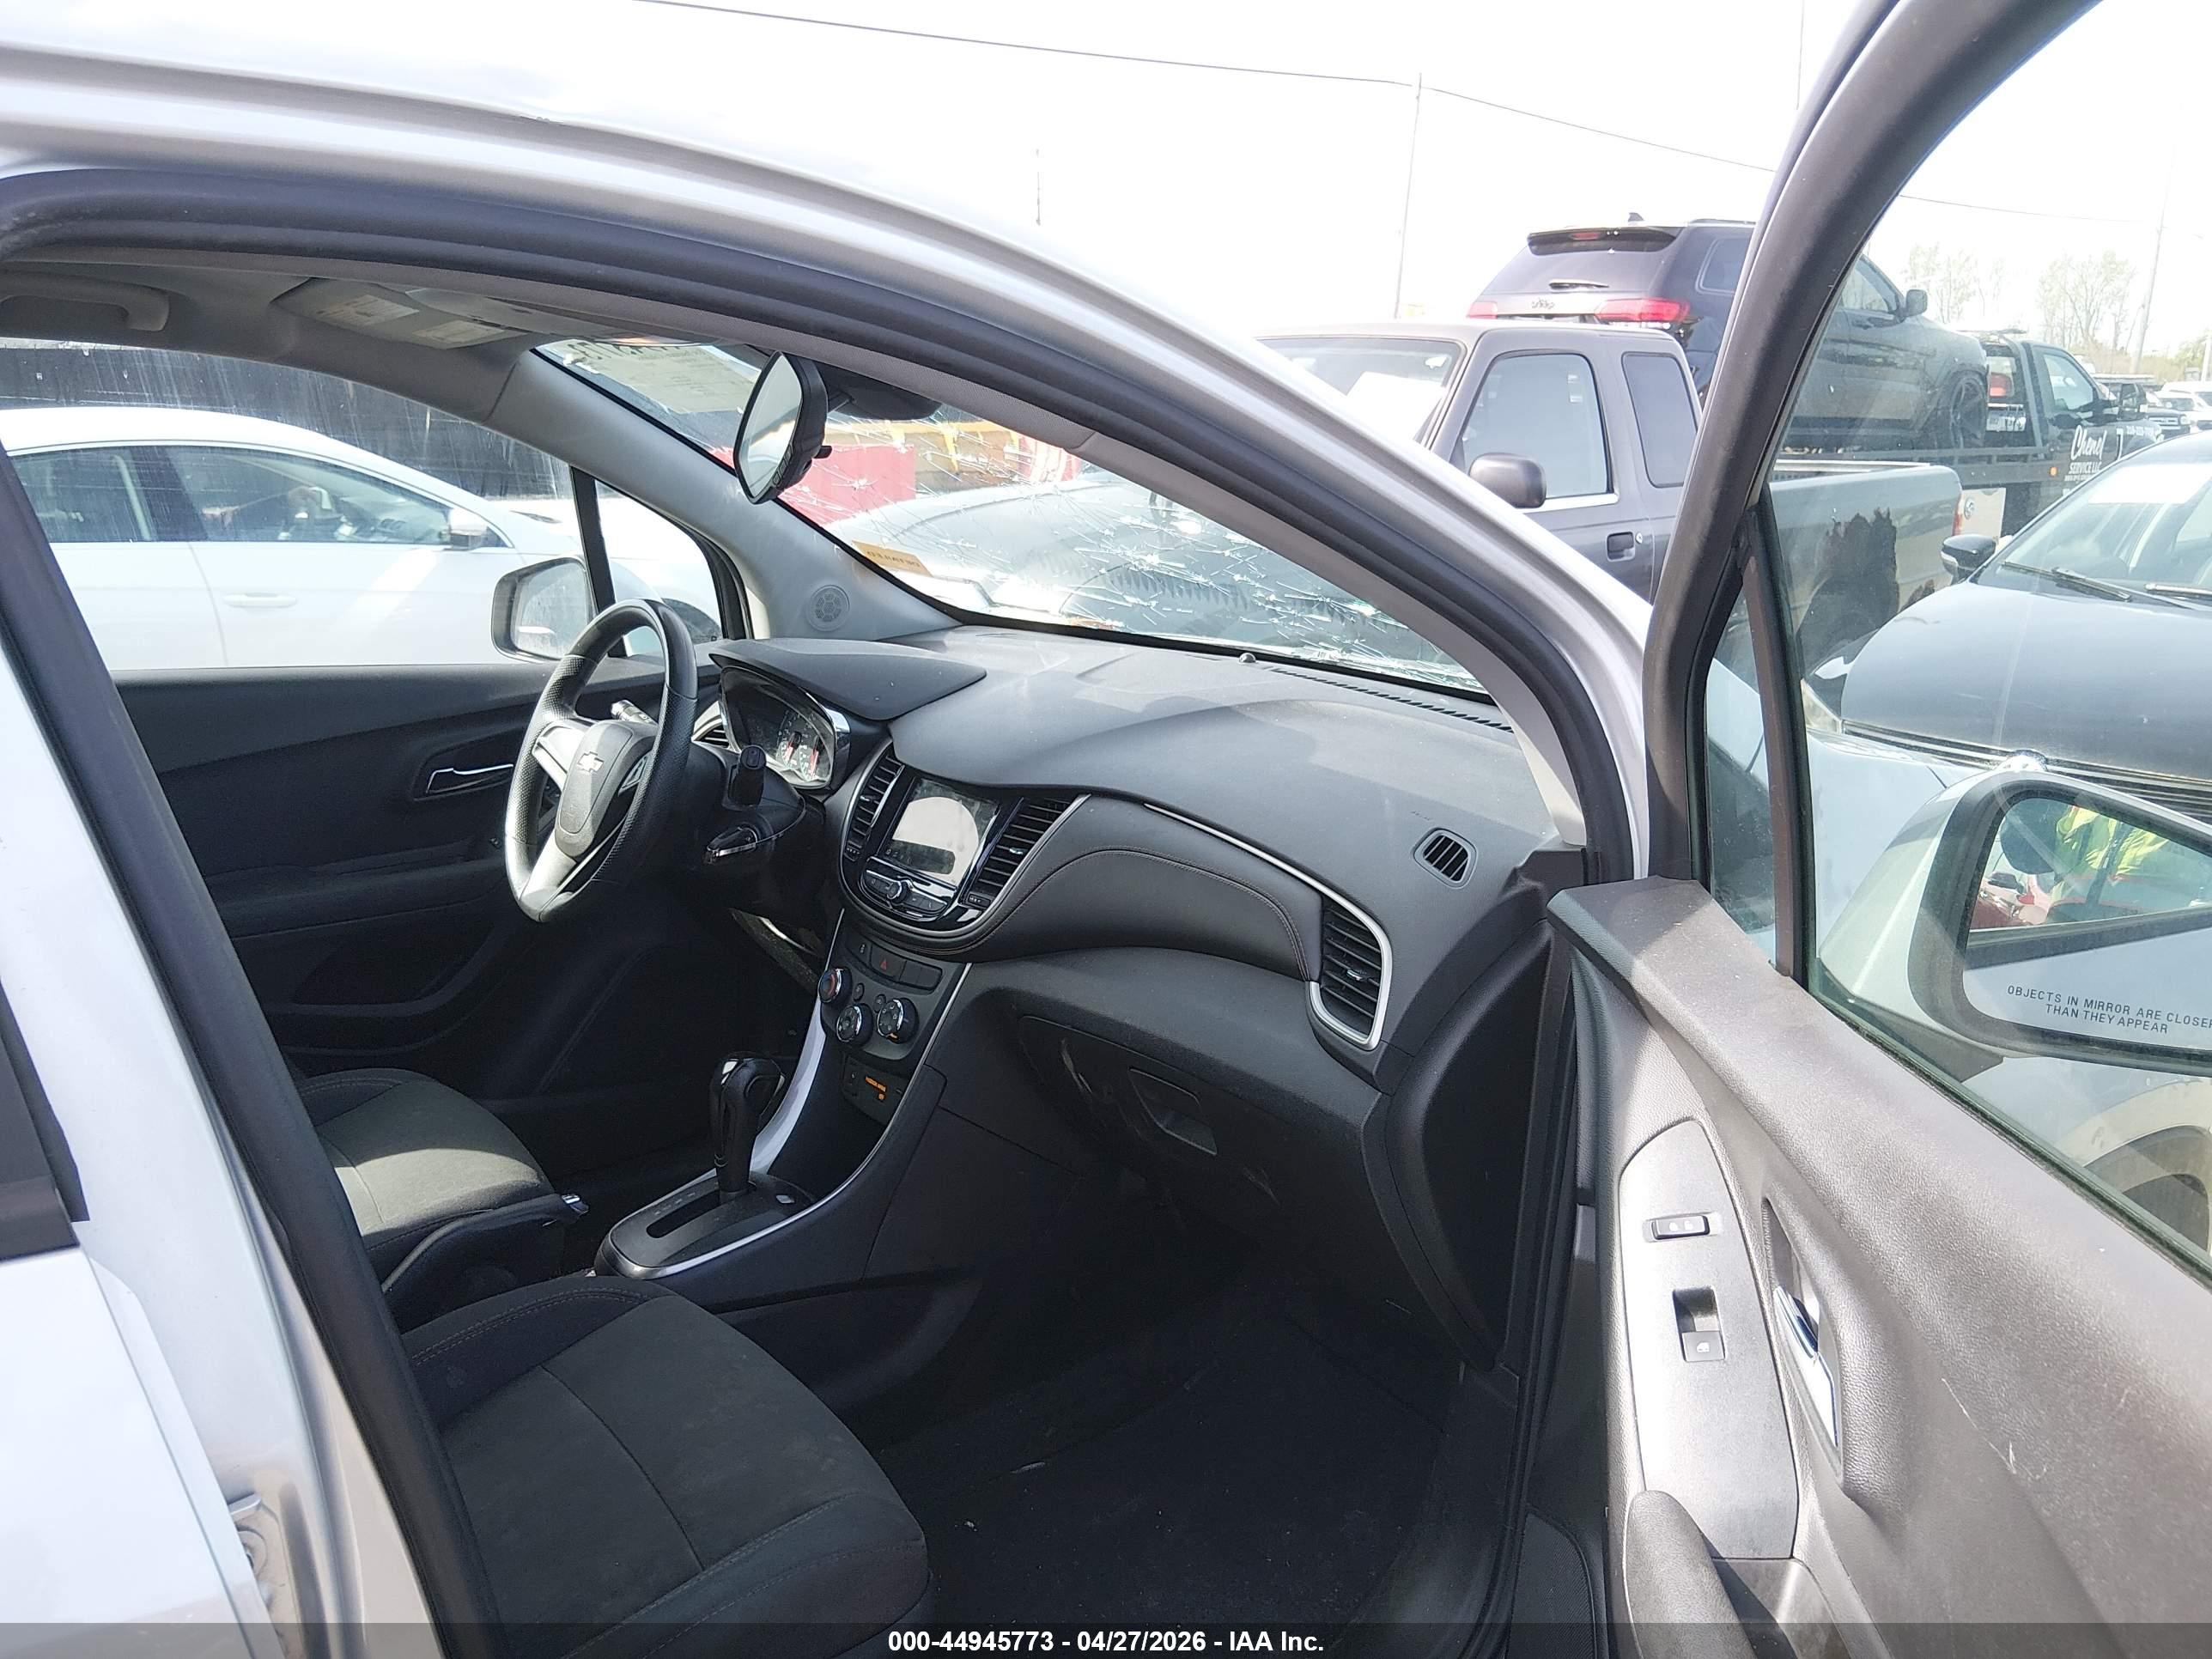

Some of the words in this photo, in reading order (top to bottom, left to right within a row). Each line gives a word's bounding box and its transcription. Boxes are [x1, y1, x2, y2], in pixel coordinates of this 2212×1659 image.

[2008, 985, 2062, 1003] OBJECTS
[2067, 996, 2079, 1006] IN
[2084, 999, 2130, 1015] MIRROR
[2136, 1007, 2162, 1020] ARE
[2045, 1004, 2079, 1018] THAN
[2083, 1010, 2115, 1024] THEY
[2117, 1017, 2168, 1034] APPEAR
